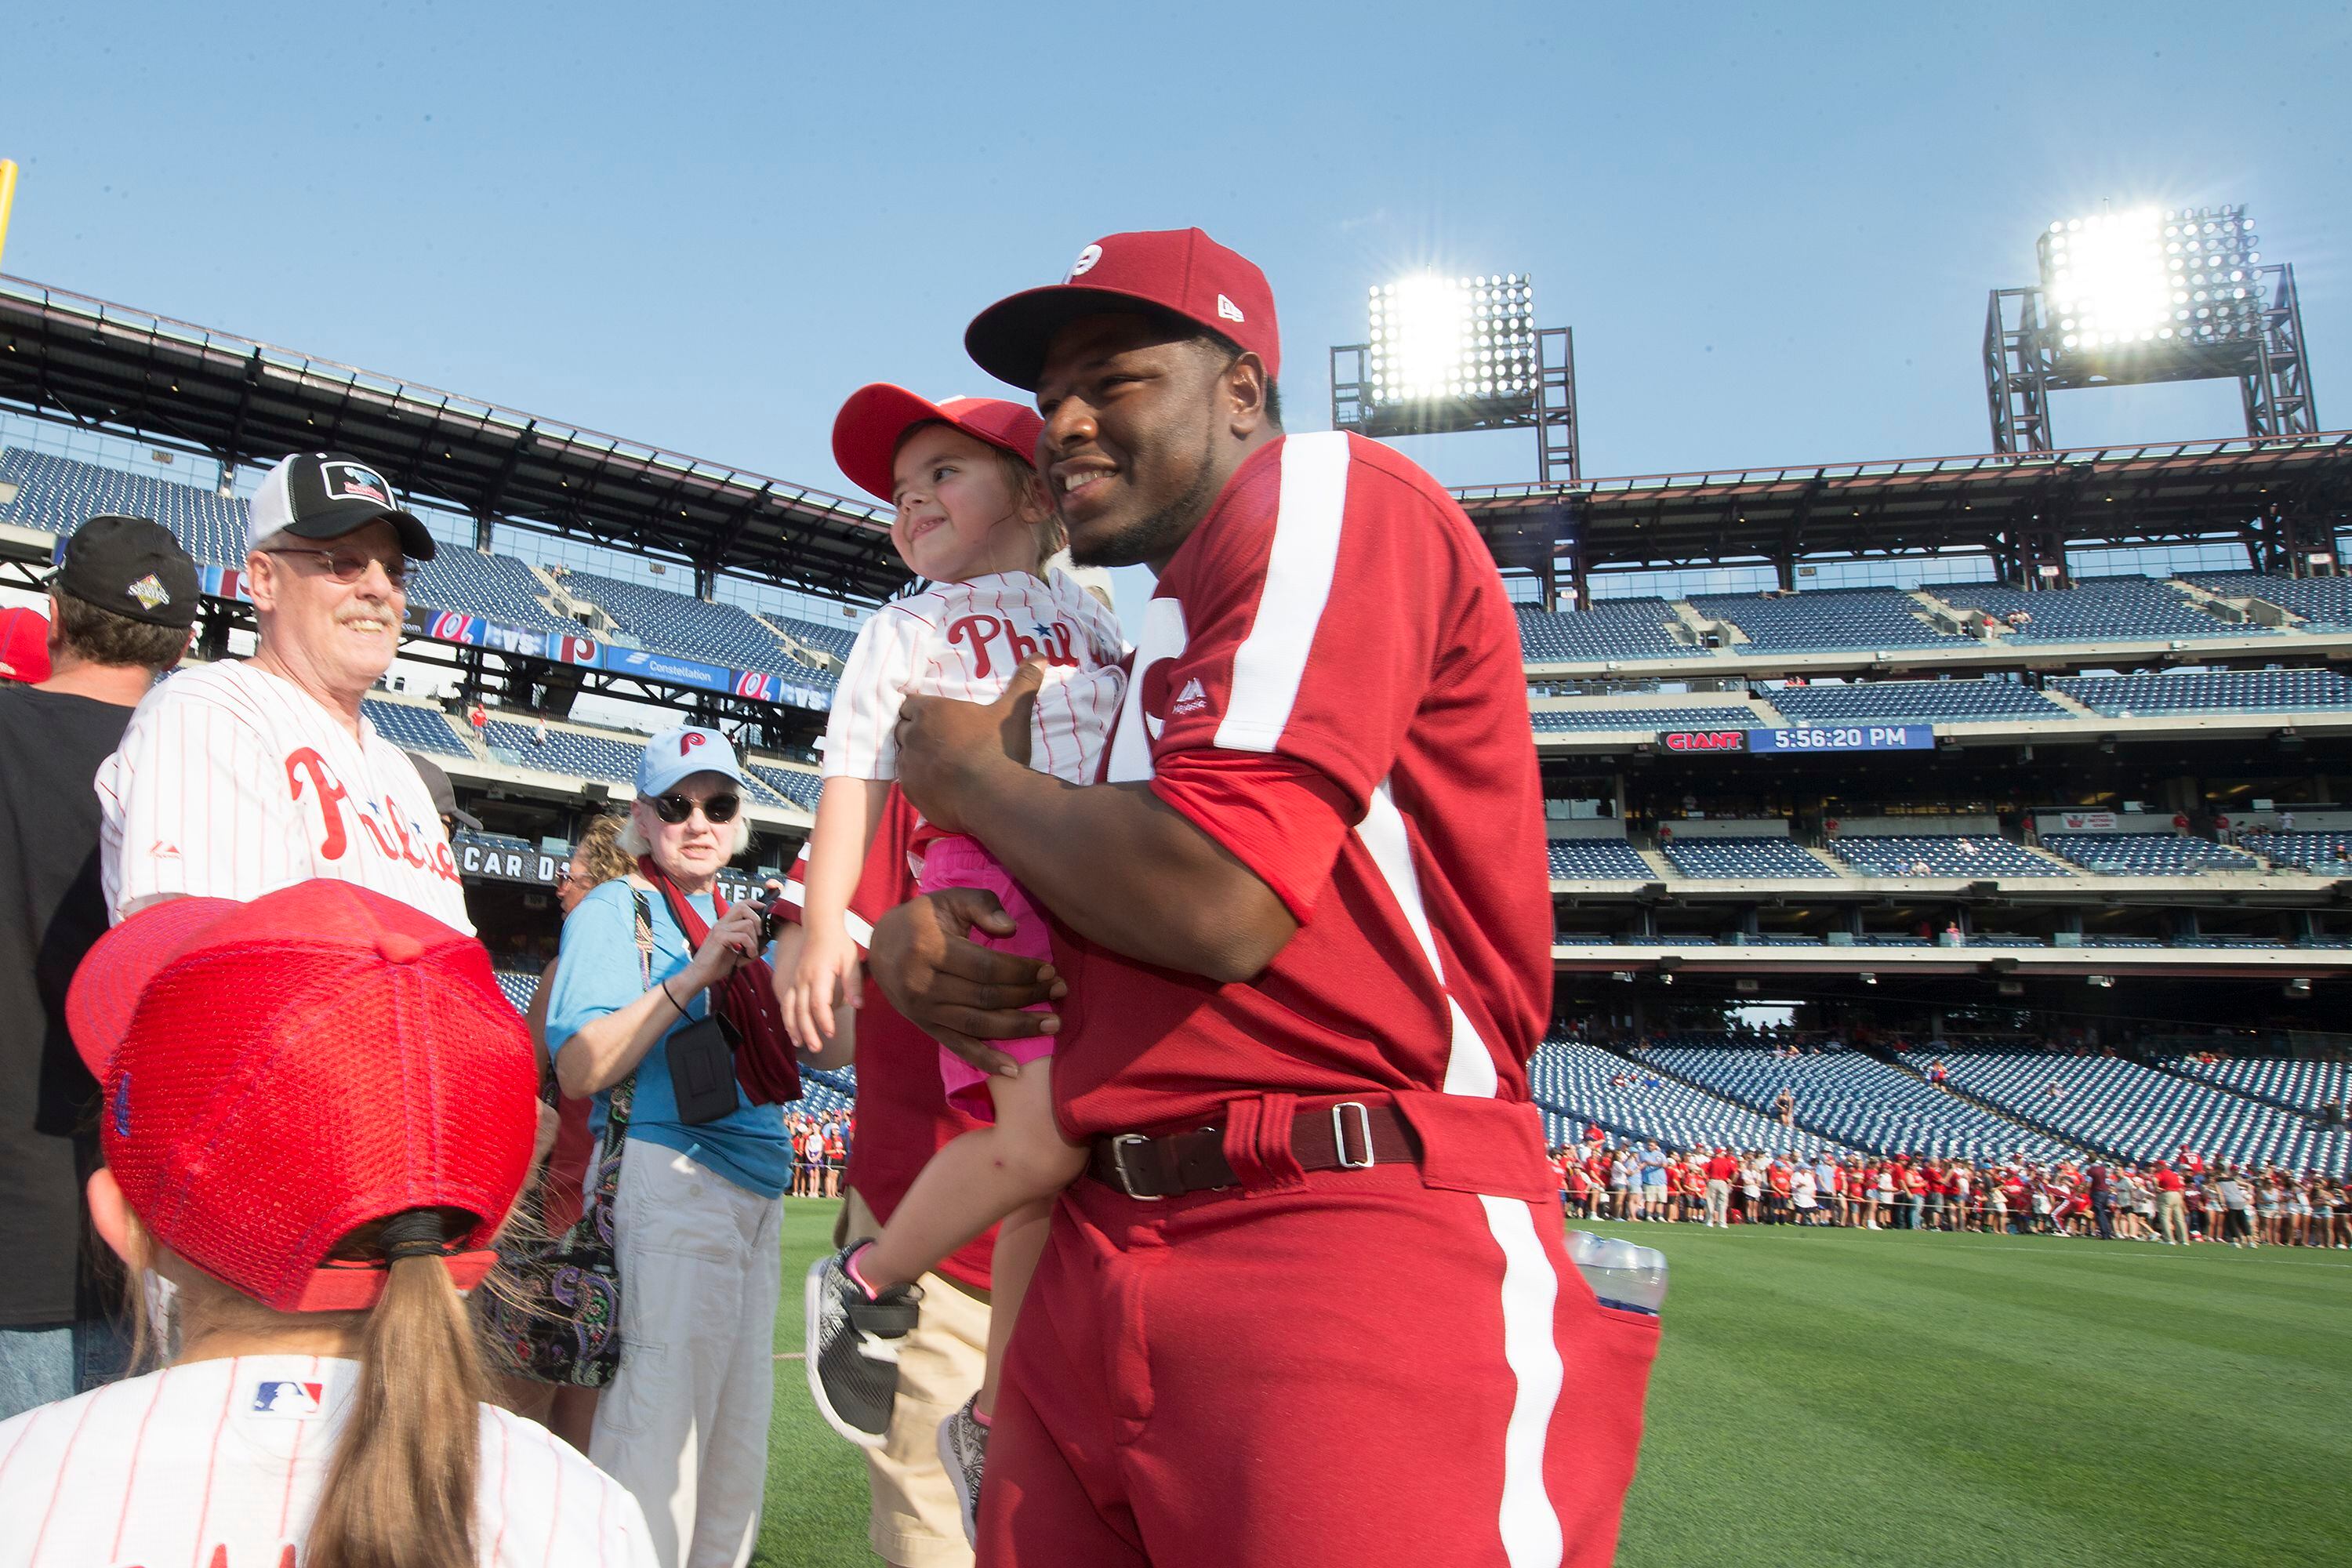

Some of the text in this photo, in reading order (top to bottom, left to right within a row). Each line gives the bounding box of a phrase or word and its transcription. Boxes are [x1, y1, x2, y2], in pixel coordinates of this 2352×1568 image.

[1062, 244, 1103, 285] P
[649, 660, 713, 682] Constellation
[681, 732, 706, 757] P
[1666, 731, 1742, 751] GIANT
[1774, 728, 1907, 748] 5:56:20 PM
[463, 846, 523, 878] CAR
